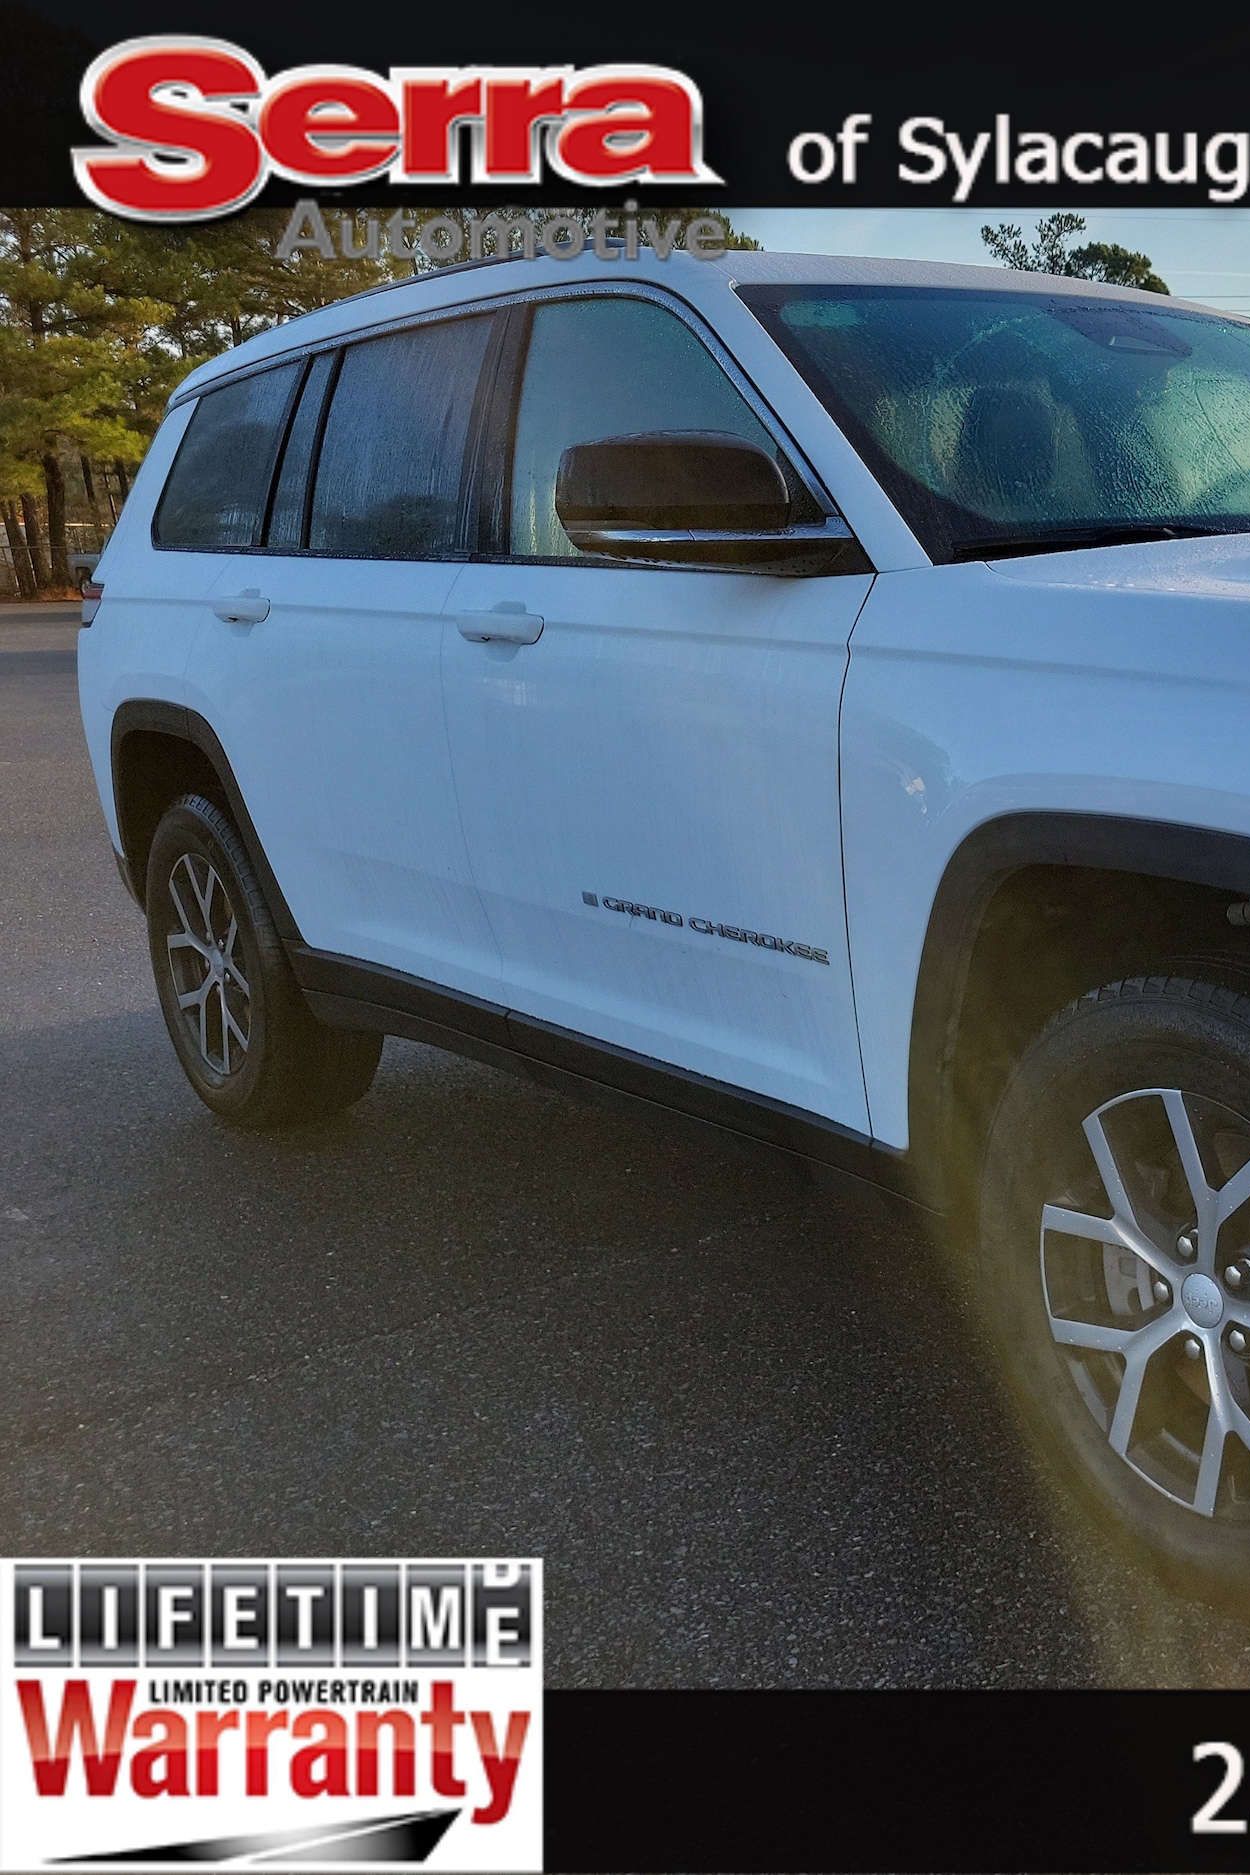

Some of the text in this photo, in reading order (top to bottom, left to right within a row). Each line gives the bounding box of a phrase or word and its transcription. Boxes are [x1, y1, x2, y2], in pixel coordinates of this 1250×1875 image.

[602, 896, 830, 965] GRAND CHEROKEE
[1187, 1292, 1219, 1314] Jeep
